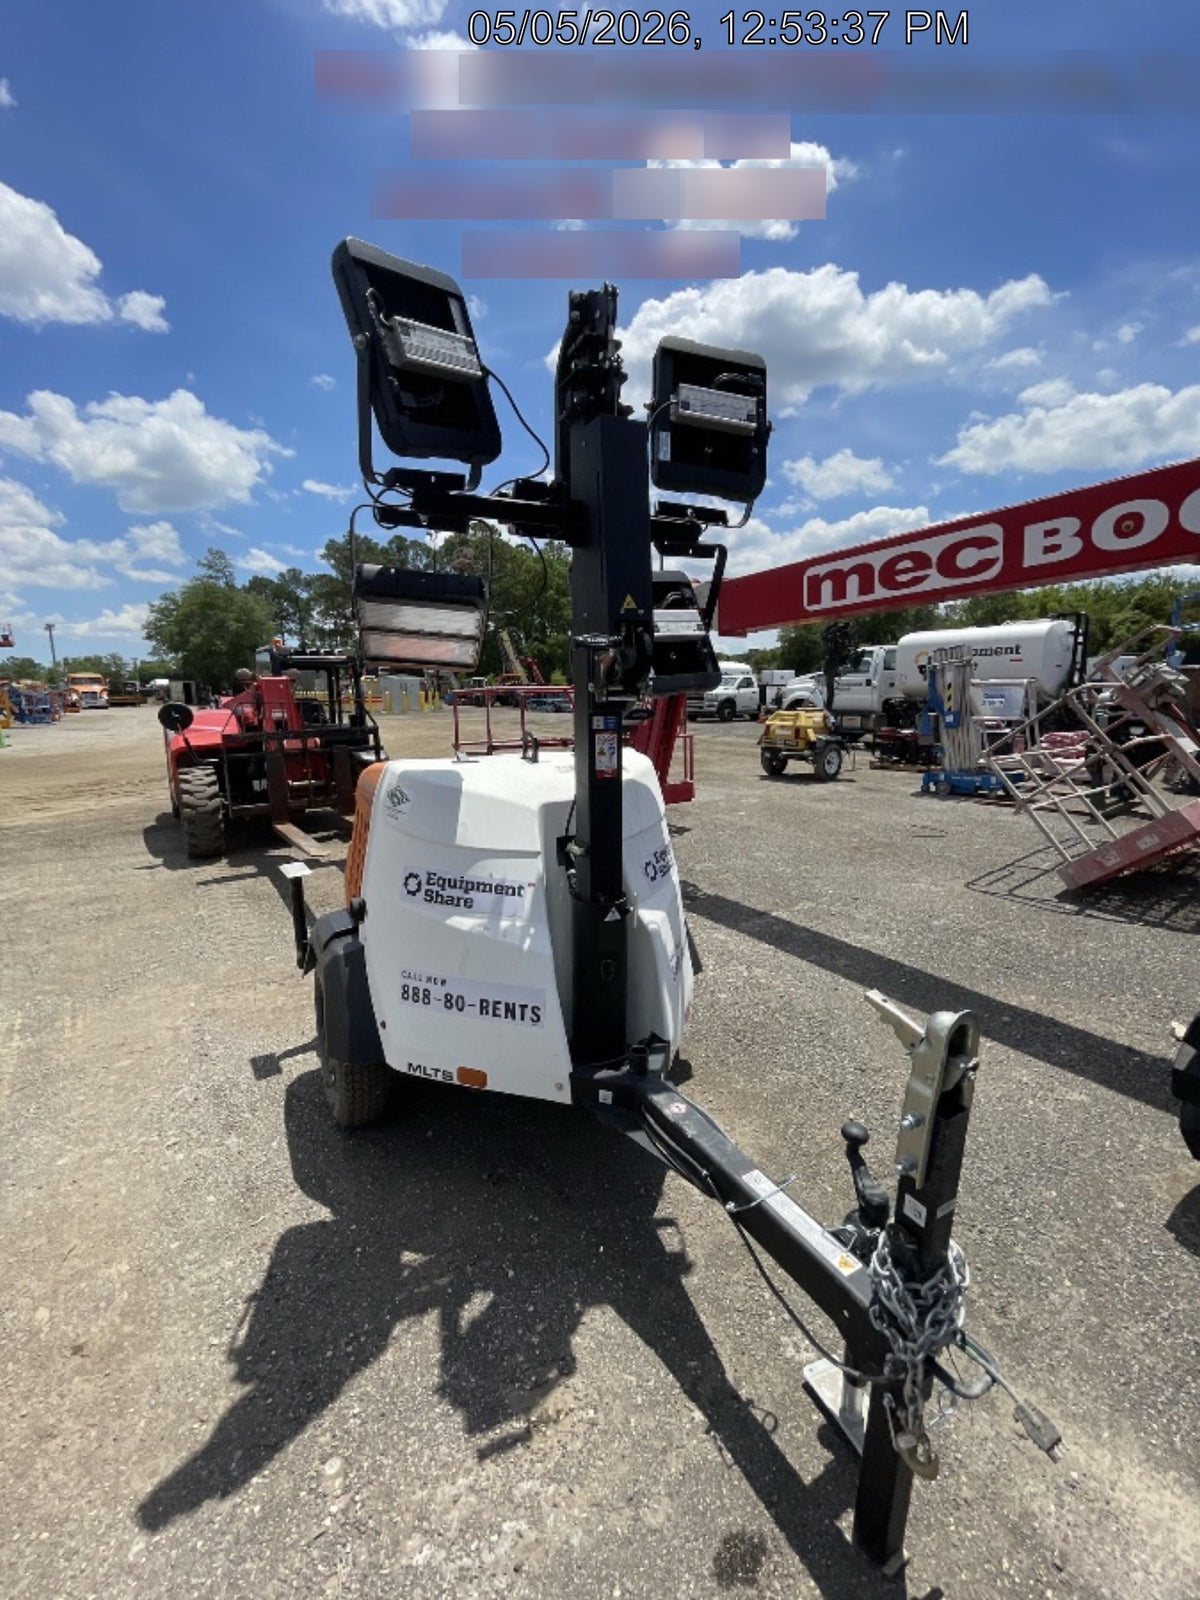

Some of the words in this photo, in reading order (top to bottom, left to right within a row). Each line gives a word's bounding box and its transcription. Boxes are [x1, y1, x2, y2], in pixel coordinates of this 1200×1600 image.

[806, 534, 1001, 607] mec
[1023, 487, 1200, 568] BO
[423, 888, 474, 909] Share
[425, 871, 526, 898] Equipment
[401, 983, 542, 1024] 888-80-RENTS
